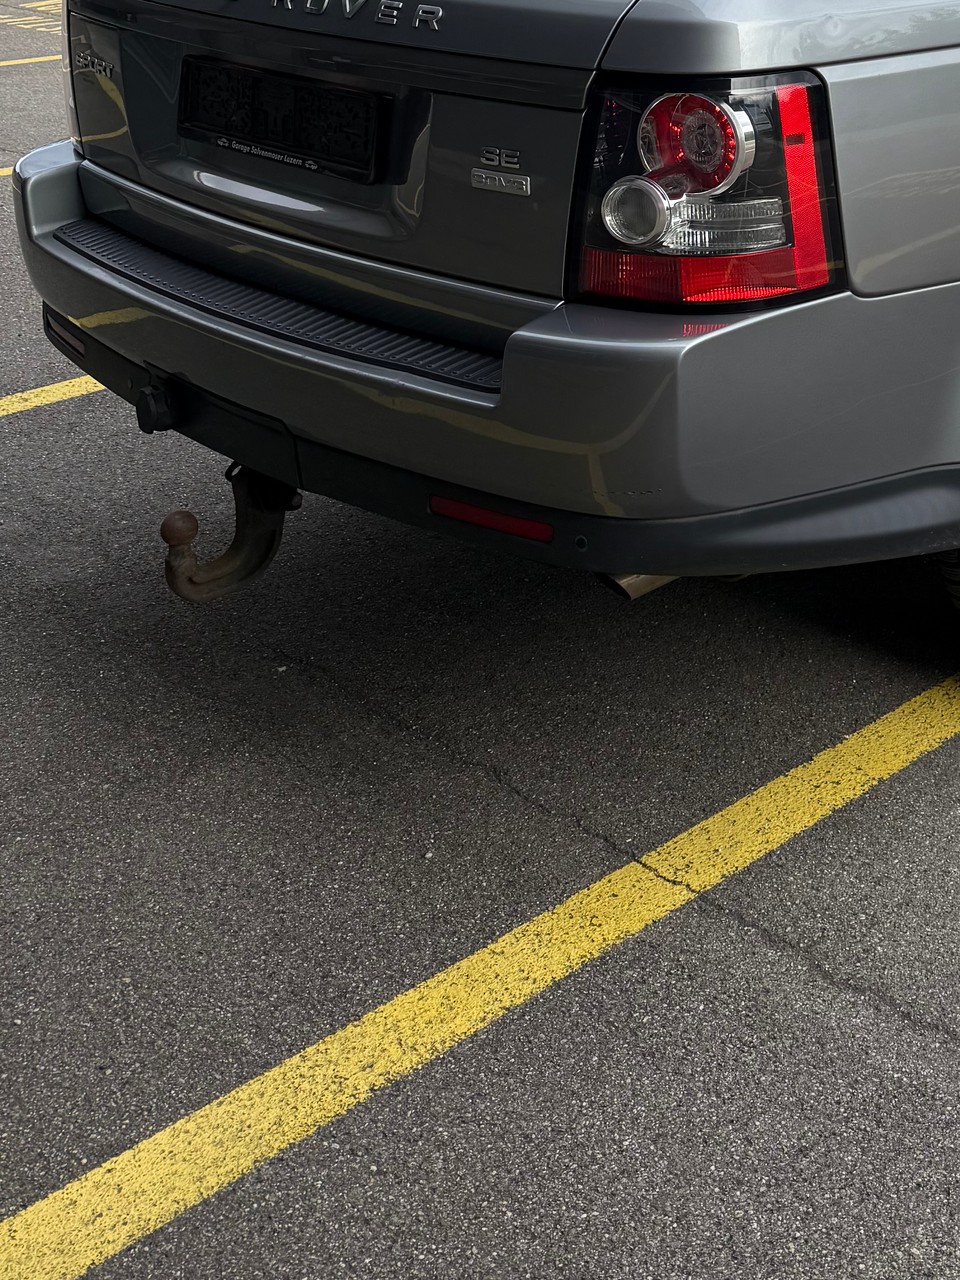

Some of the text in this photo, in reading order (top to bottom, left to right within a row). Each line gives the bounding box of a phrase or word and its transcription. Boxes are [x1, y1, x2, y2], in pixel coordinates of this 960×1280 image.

[76, 51, 114, 78] SPORT
[231, 141, 250, 153] Garage
[284, 154, 302, 165] Luzern
[480, 146, 520, 169] SE
